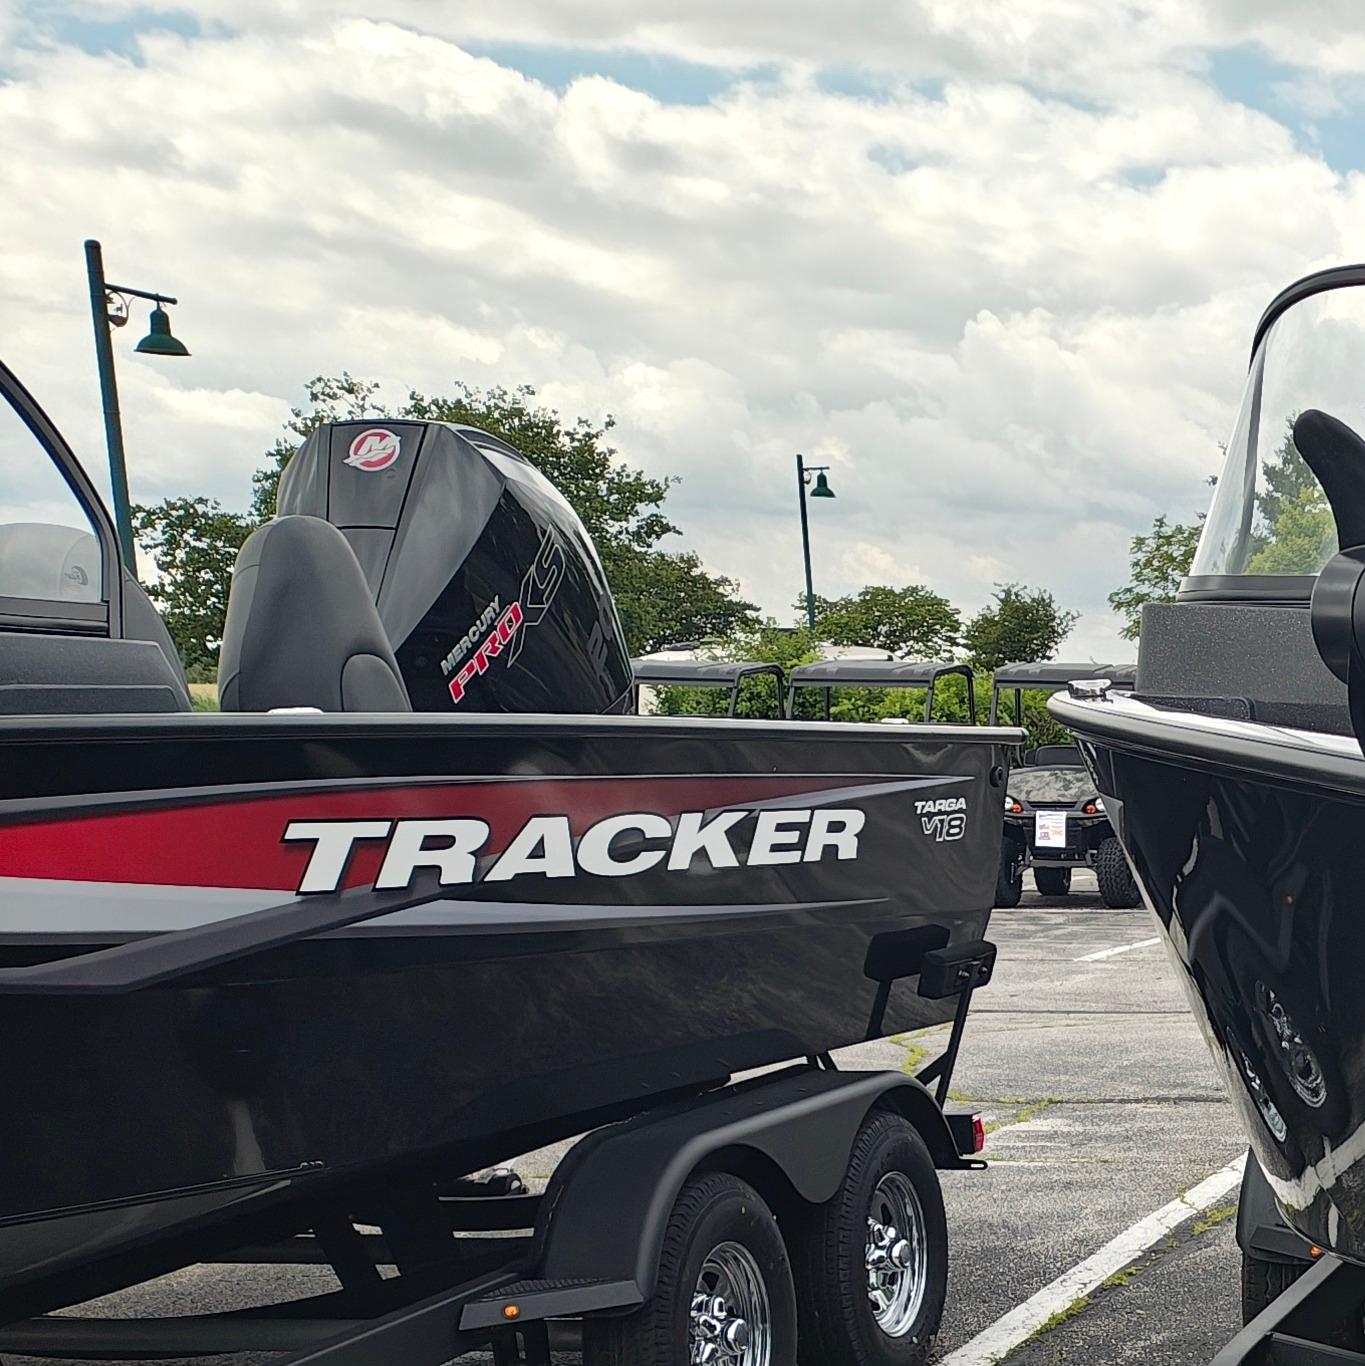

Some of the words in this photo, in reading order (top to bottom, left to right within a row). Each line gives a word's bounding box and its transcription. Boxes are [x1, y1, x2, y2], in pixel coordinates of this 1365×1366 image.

[440, 595, 501, 676] MERCURY
[914, 797, 967, 814] TARGA
[921, 813, 967, 842] V18
[282, 808, 867, 895] TRACKER
